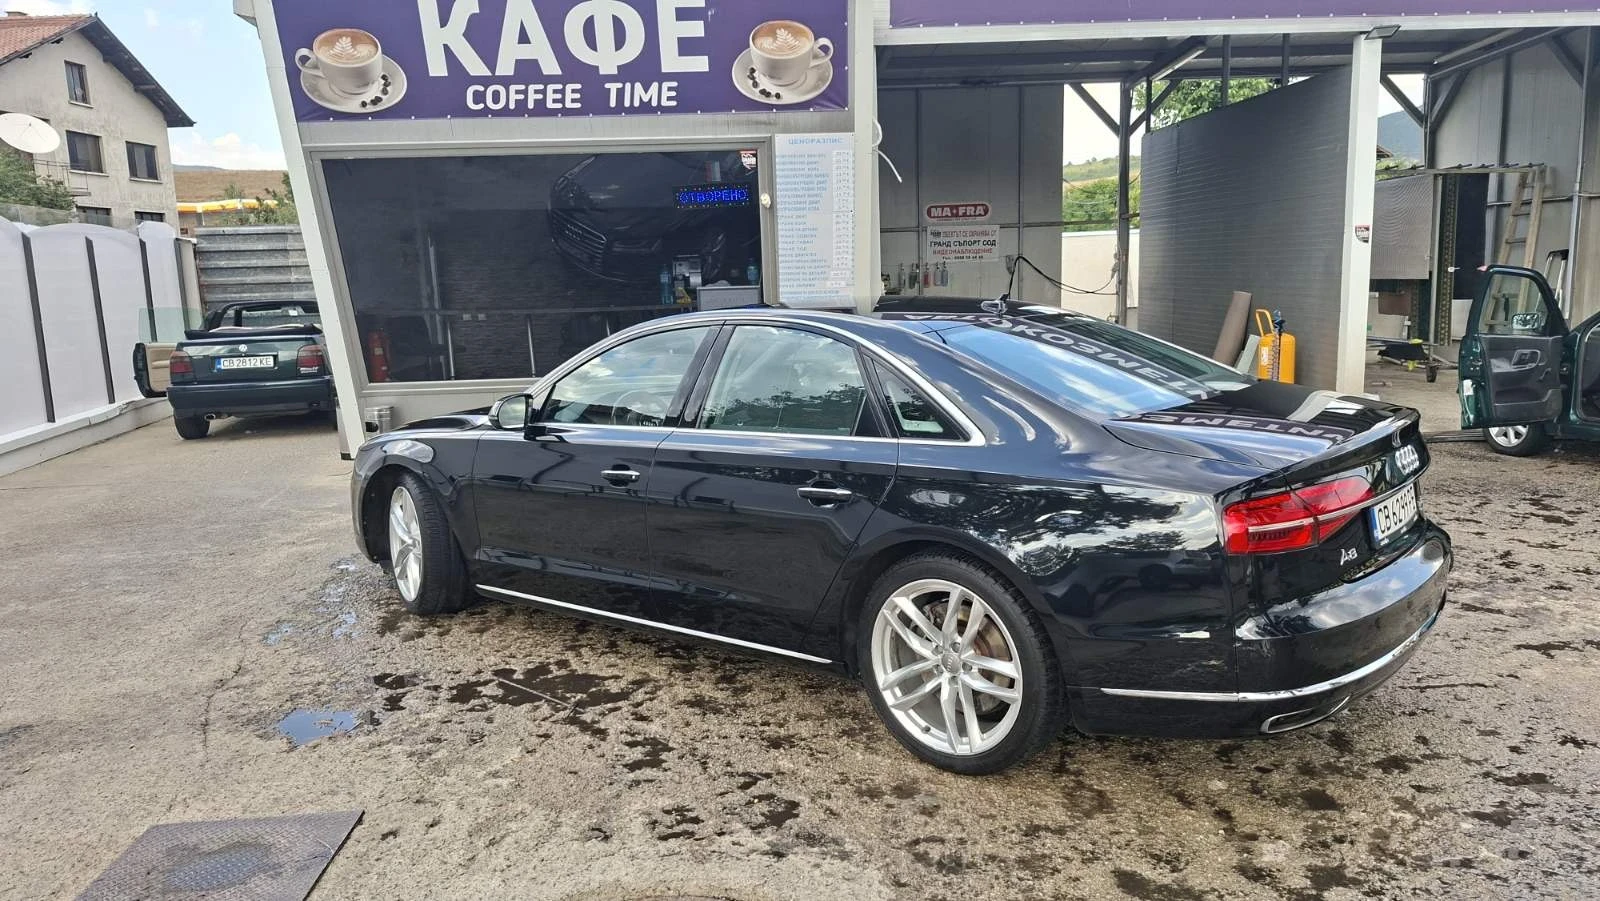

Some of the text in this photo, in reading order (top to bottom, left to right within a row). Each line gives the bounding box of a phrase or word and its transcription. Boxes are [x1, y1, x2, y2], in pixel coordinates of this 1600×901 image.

[417, 0, 709, 76] КАФЕ
[466, 81, 678, 110] COFFEE TIME
[679, 188, 748, 204] ОТВОРЕНО
[929, 240, 952, 248] ГРАНД
[982, 239, 997, 247] СОД
[1339, 547, 1358, 566] A8
